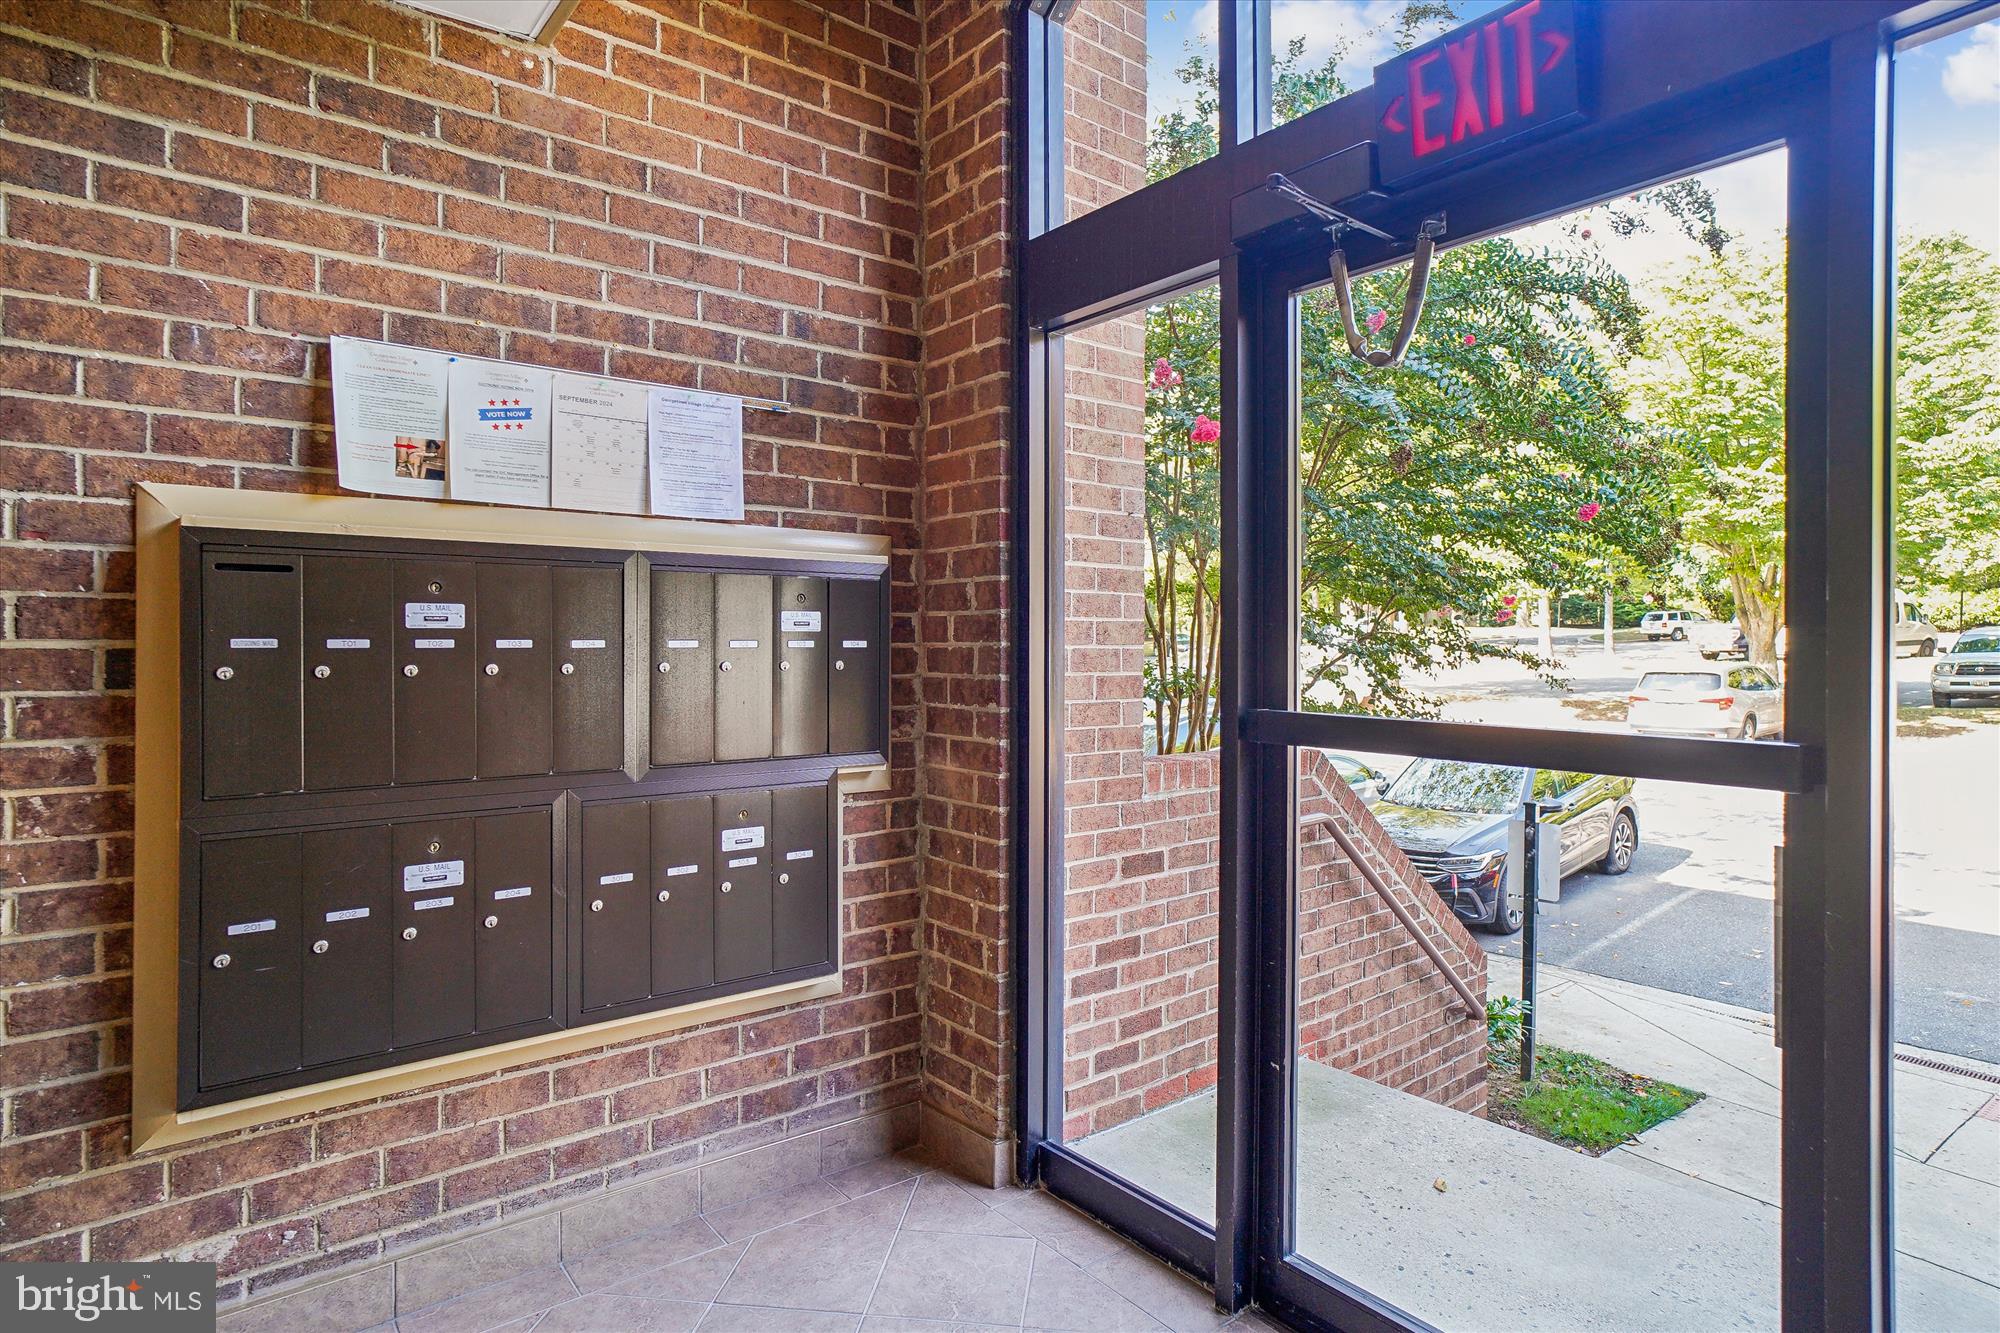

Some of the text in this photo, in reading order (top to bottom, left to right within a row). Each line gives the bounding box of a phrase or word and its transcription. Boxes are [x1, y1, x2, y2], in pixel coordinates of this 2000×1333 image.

[1408, 0, 1541, 159] EXIT
[559, 394, 598, 405] SEPTEMBER
[418, 863, 451, 873] U.S. MAIL
[504, 889, 522, 897] 204
[425, 899, 443, 908] 203
[338, 910, 357, 919] 202
[243, 923, 261, 932] 201
